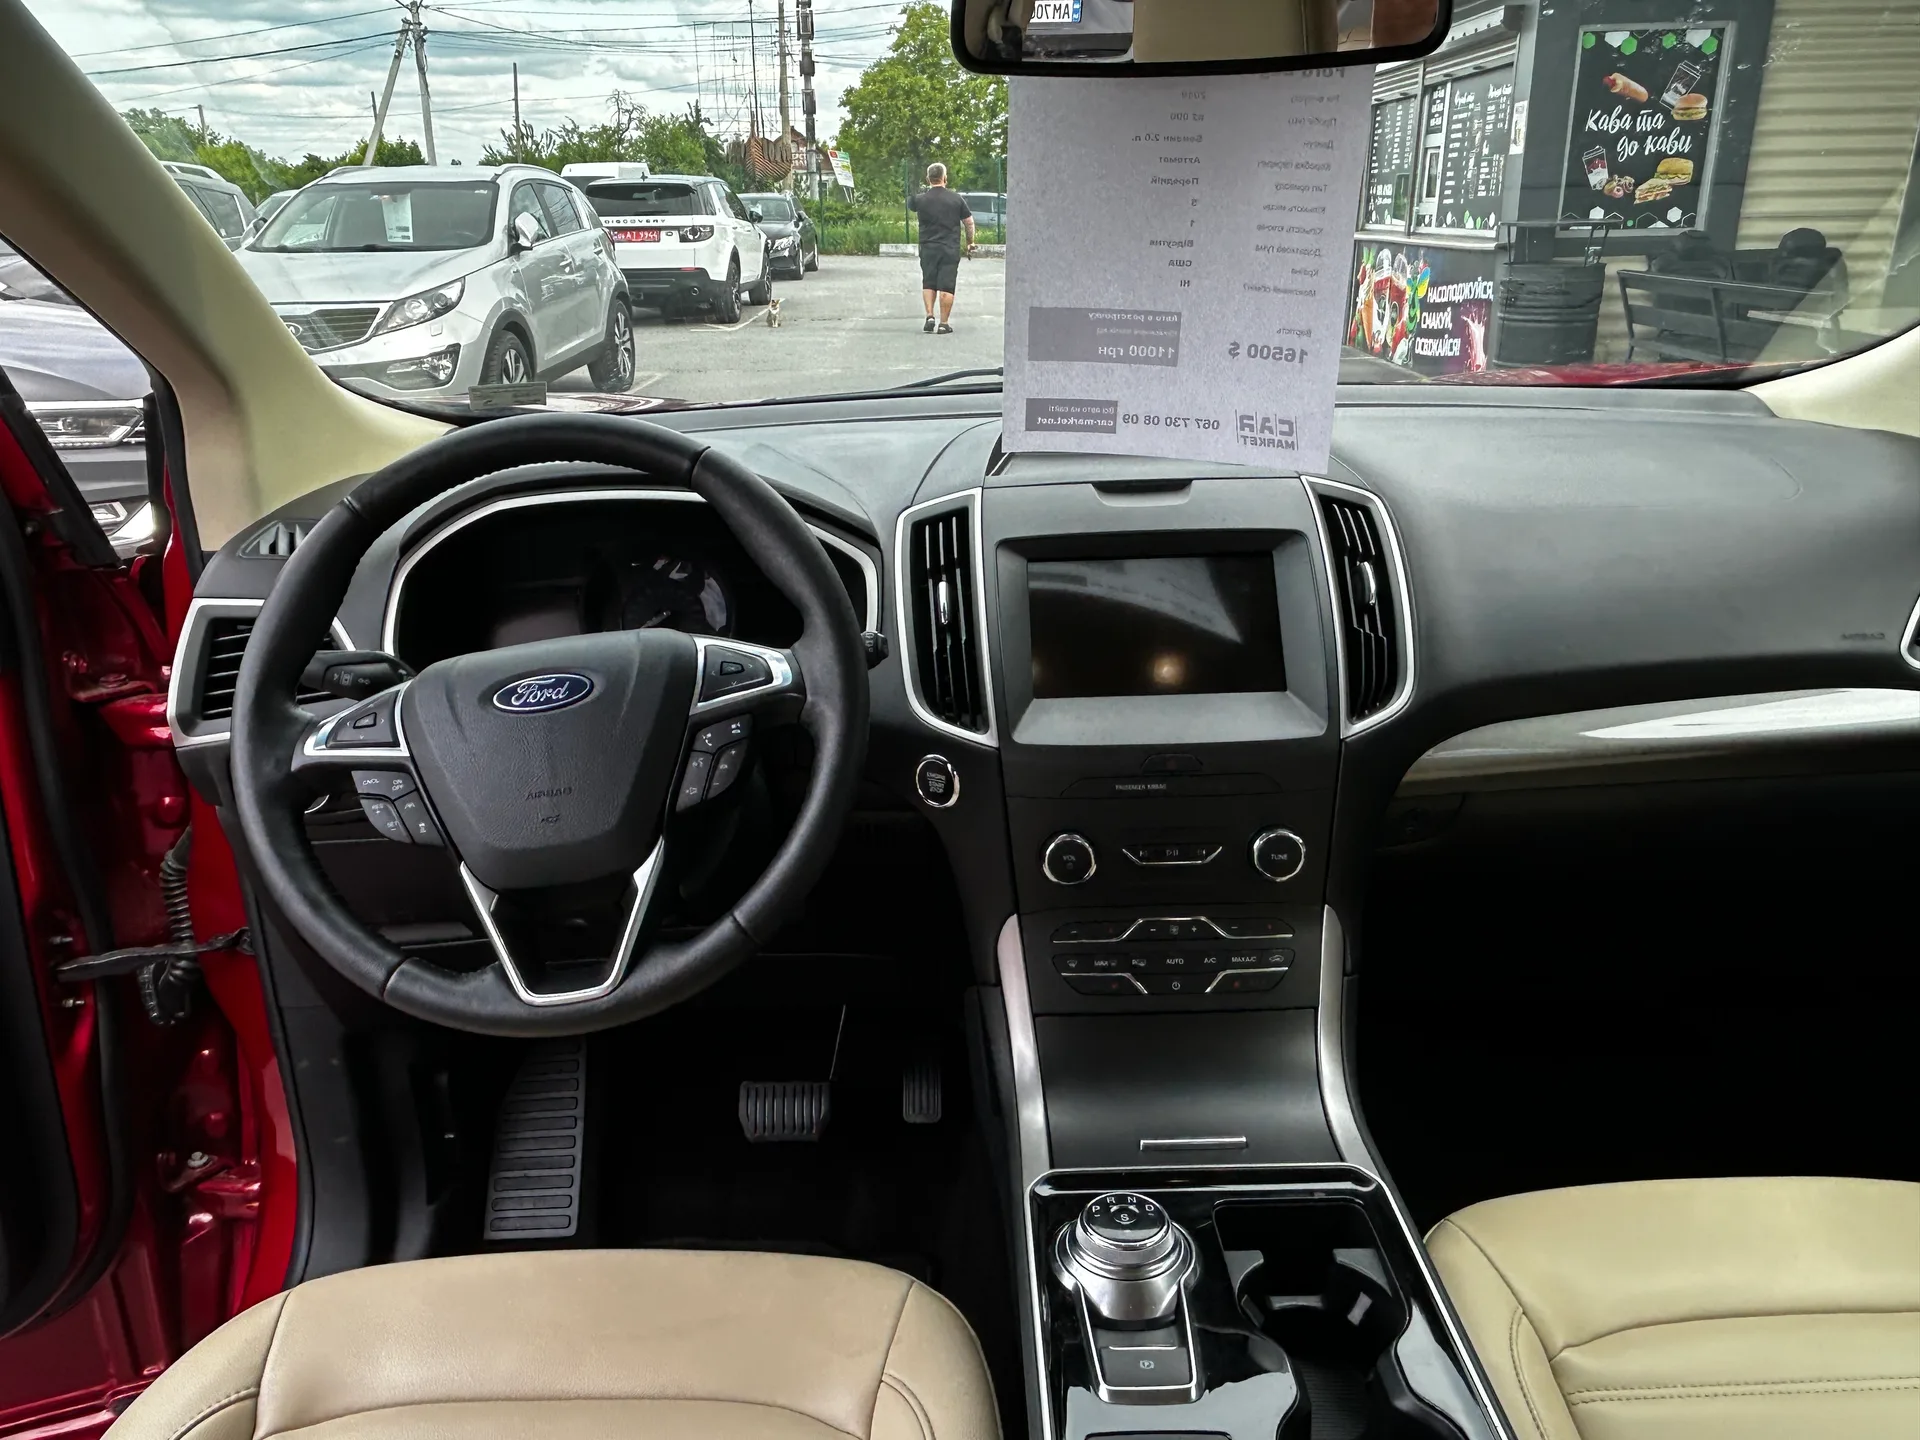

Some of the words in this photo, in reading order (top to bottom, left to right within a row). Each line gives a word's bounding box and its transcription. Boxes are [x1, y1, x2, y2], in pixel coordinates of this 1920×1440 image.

[1585, 105, 1633, 134] Кава
[1636, 109, 1666, 132] та
[1617, 136, 1639, 163] до
[1643, 127, 1692, 156] кави
[511, 678, 570, 706] Ford
[1165, 957, 1185, 966] AUTO
[1203, 956, 1218, 964] A/C
[1106, 1196, 1116, 1204] R
[1092, 1205, 1101, 1213] P
[1145, 1204, 1155, 1212] D
[1120, 1213, 1130, 1222] S
